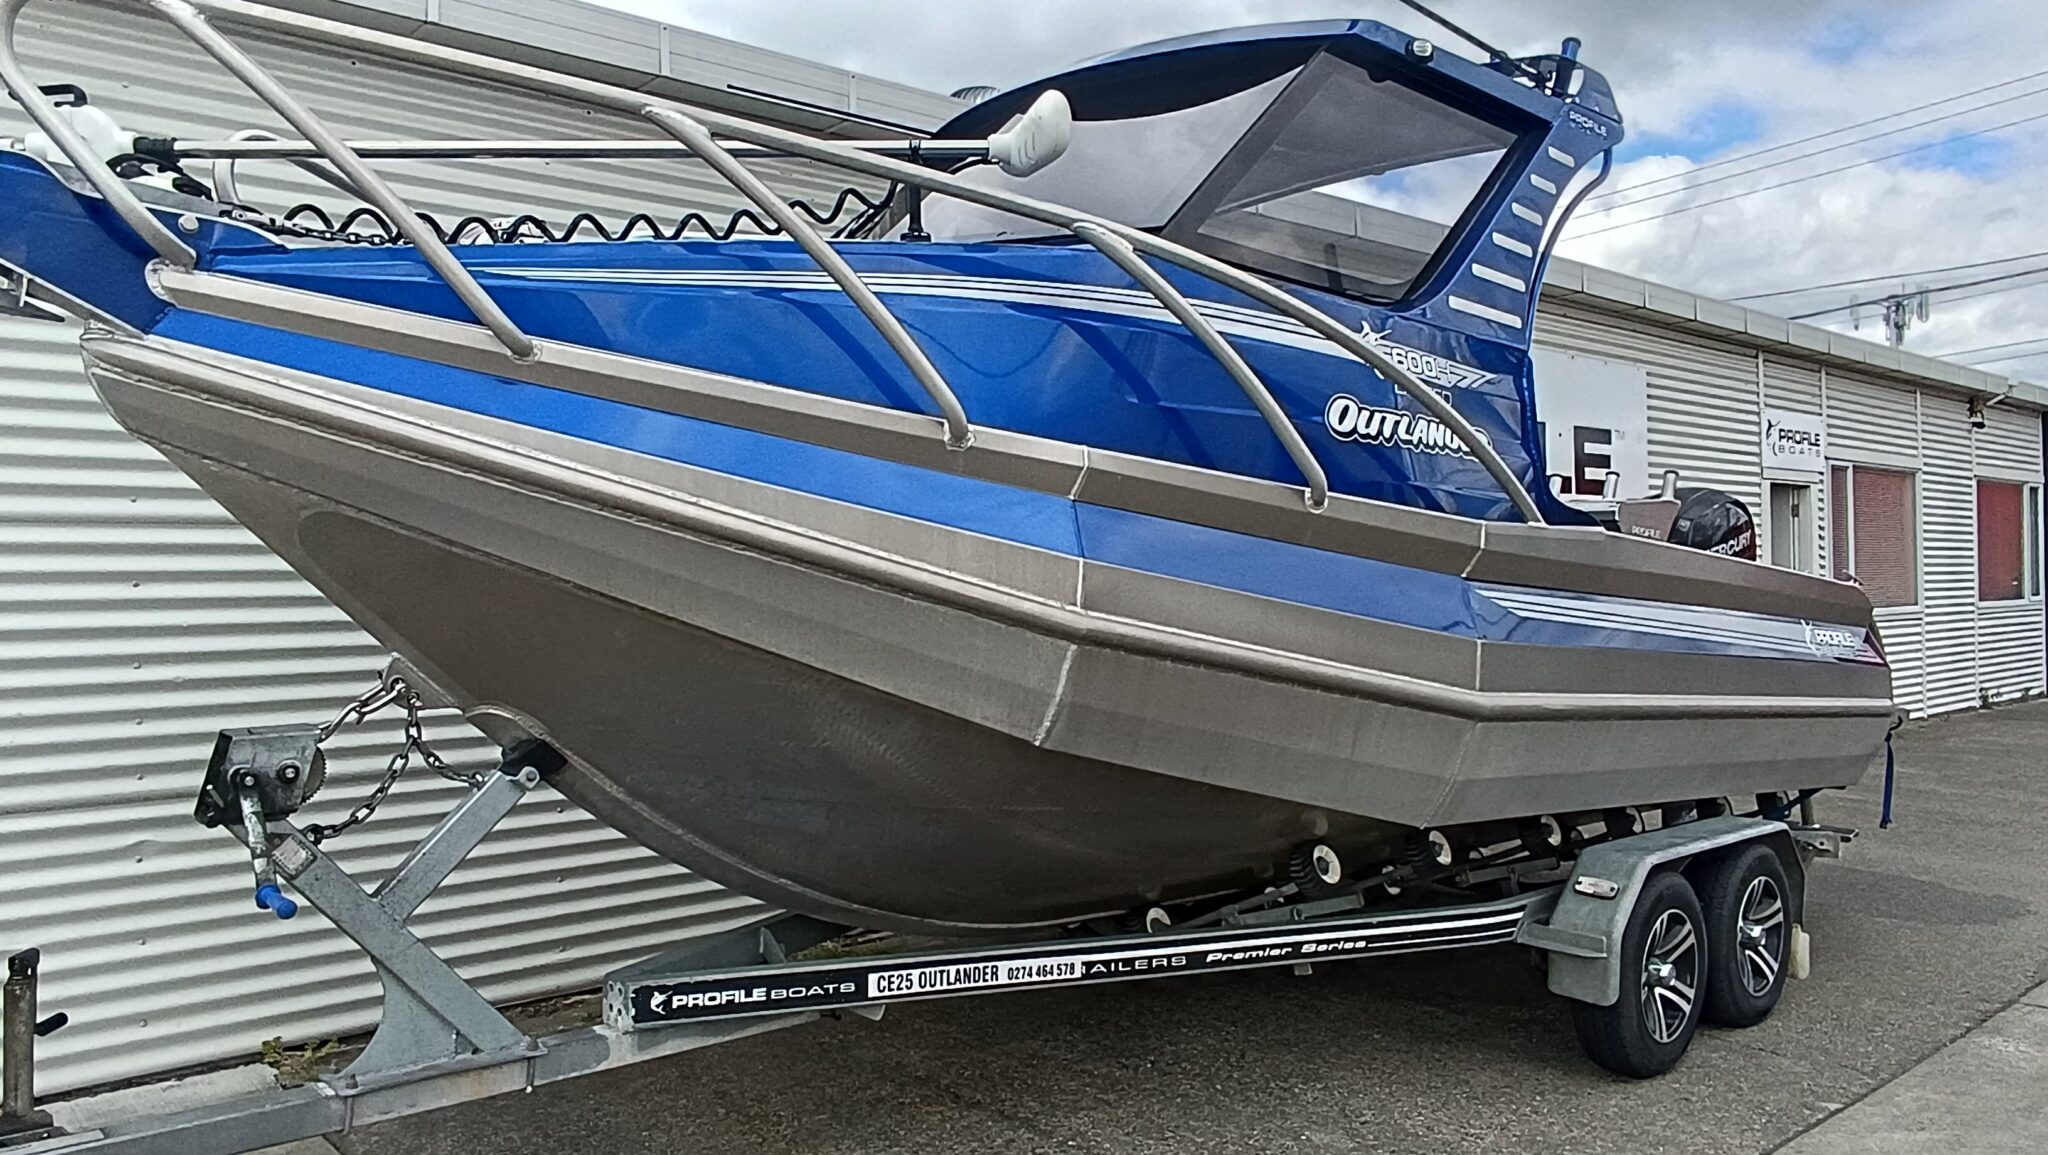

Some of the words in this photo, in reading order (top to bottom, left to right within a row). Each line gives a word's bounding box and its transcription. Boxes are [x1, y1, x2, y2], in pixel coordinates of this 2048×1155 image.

[1569, 111, 1608, 137] PROFILE
[1778, 429, 1821, 447] PROFILE
[1778, 445, 1821, 458] BOATS
[1632, 526, 1661, 539] PROFILE
[1206, 945, 1293, 963] Premier
[1301, 938, 1368, 954] Series
[877, 971, 914, 994] CE25
[919, 964, 1000, 990] OUTLANDER
[1007, 964, 1034, 981] 0274
[1035, 963, 1055, 980] 464
[1056, 961, 1076, 978] 578
[672, 987, 767, 1010] PROFILE
[771, 982, 855, 1001] BOATS
